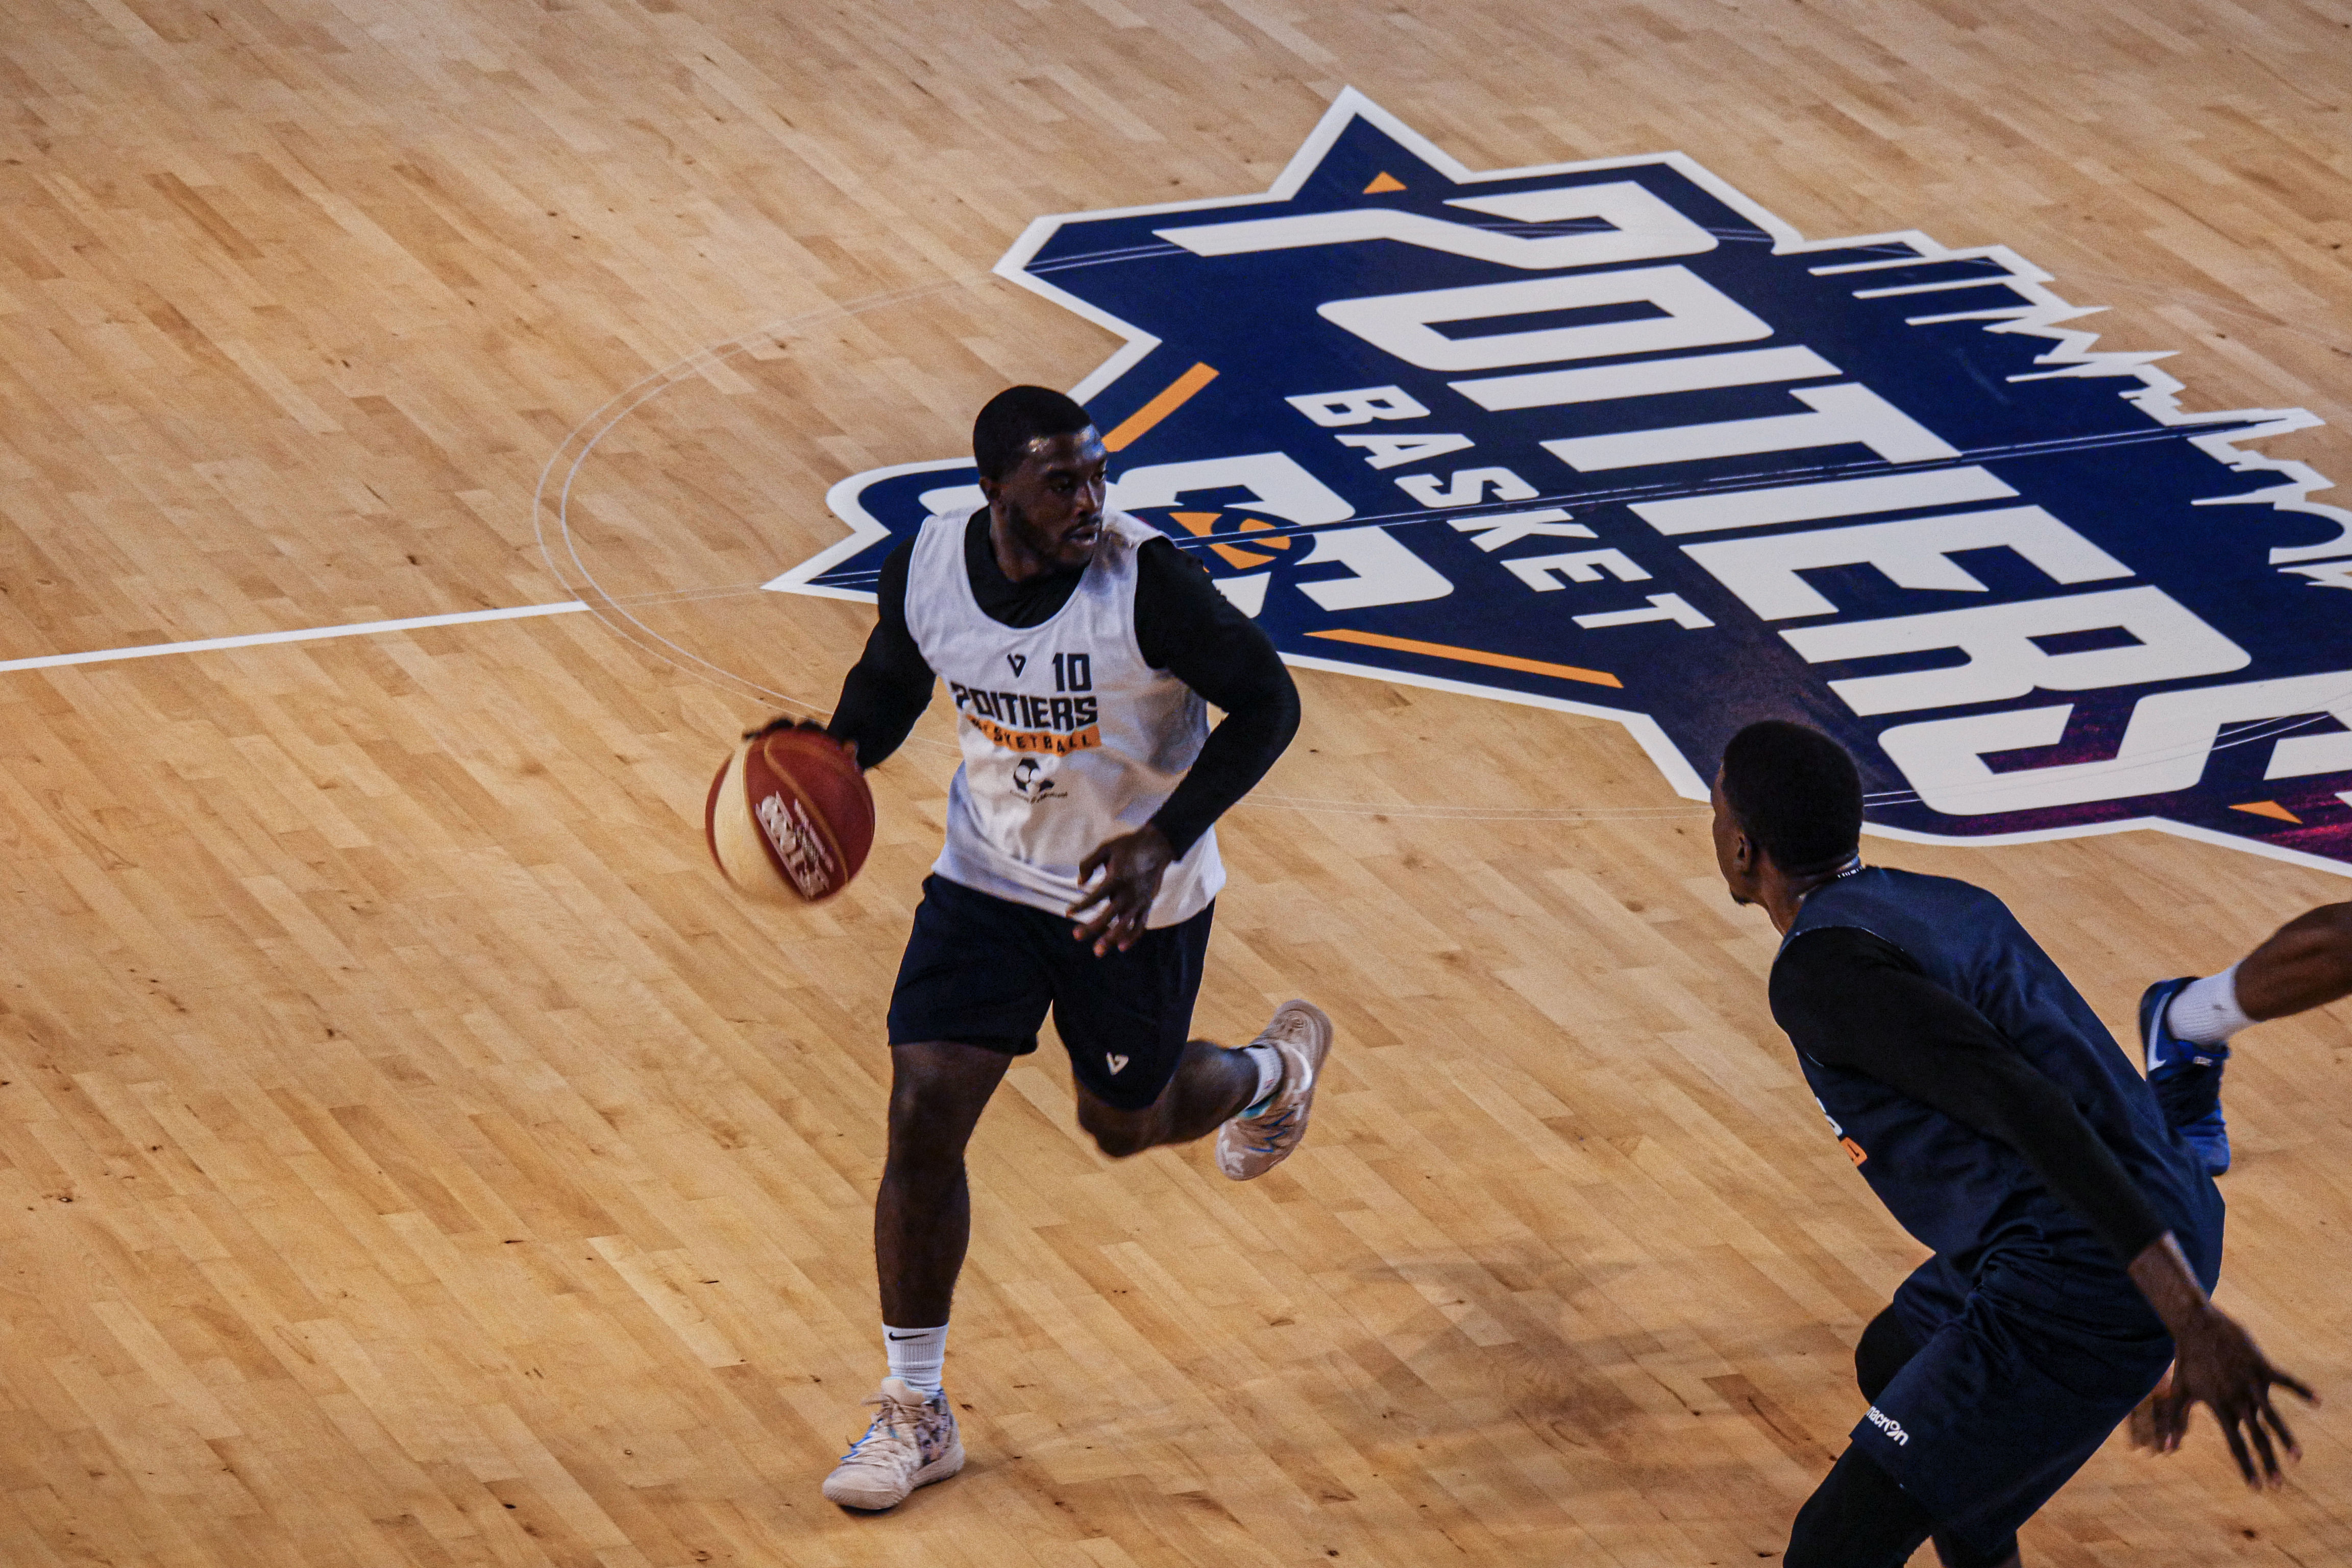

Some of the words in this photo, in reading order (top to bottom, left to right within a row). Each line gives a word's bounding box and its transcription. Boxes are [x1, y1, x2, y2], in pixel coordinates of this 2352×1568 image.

[1152, 182, 2352, 816] POITIERS
[1285, 385, 1716, 630] BASKET
[950, 681, 1097, 731] POITIERS
[1052, 653, 1092, 692] 10
